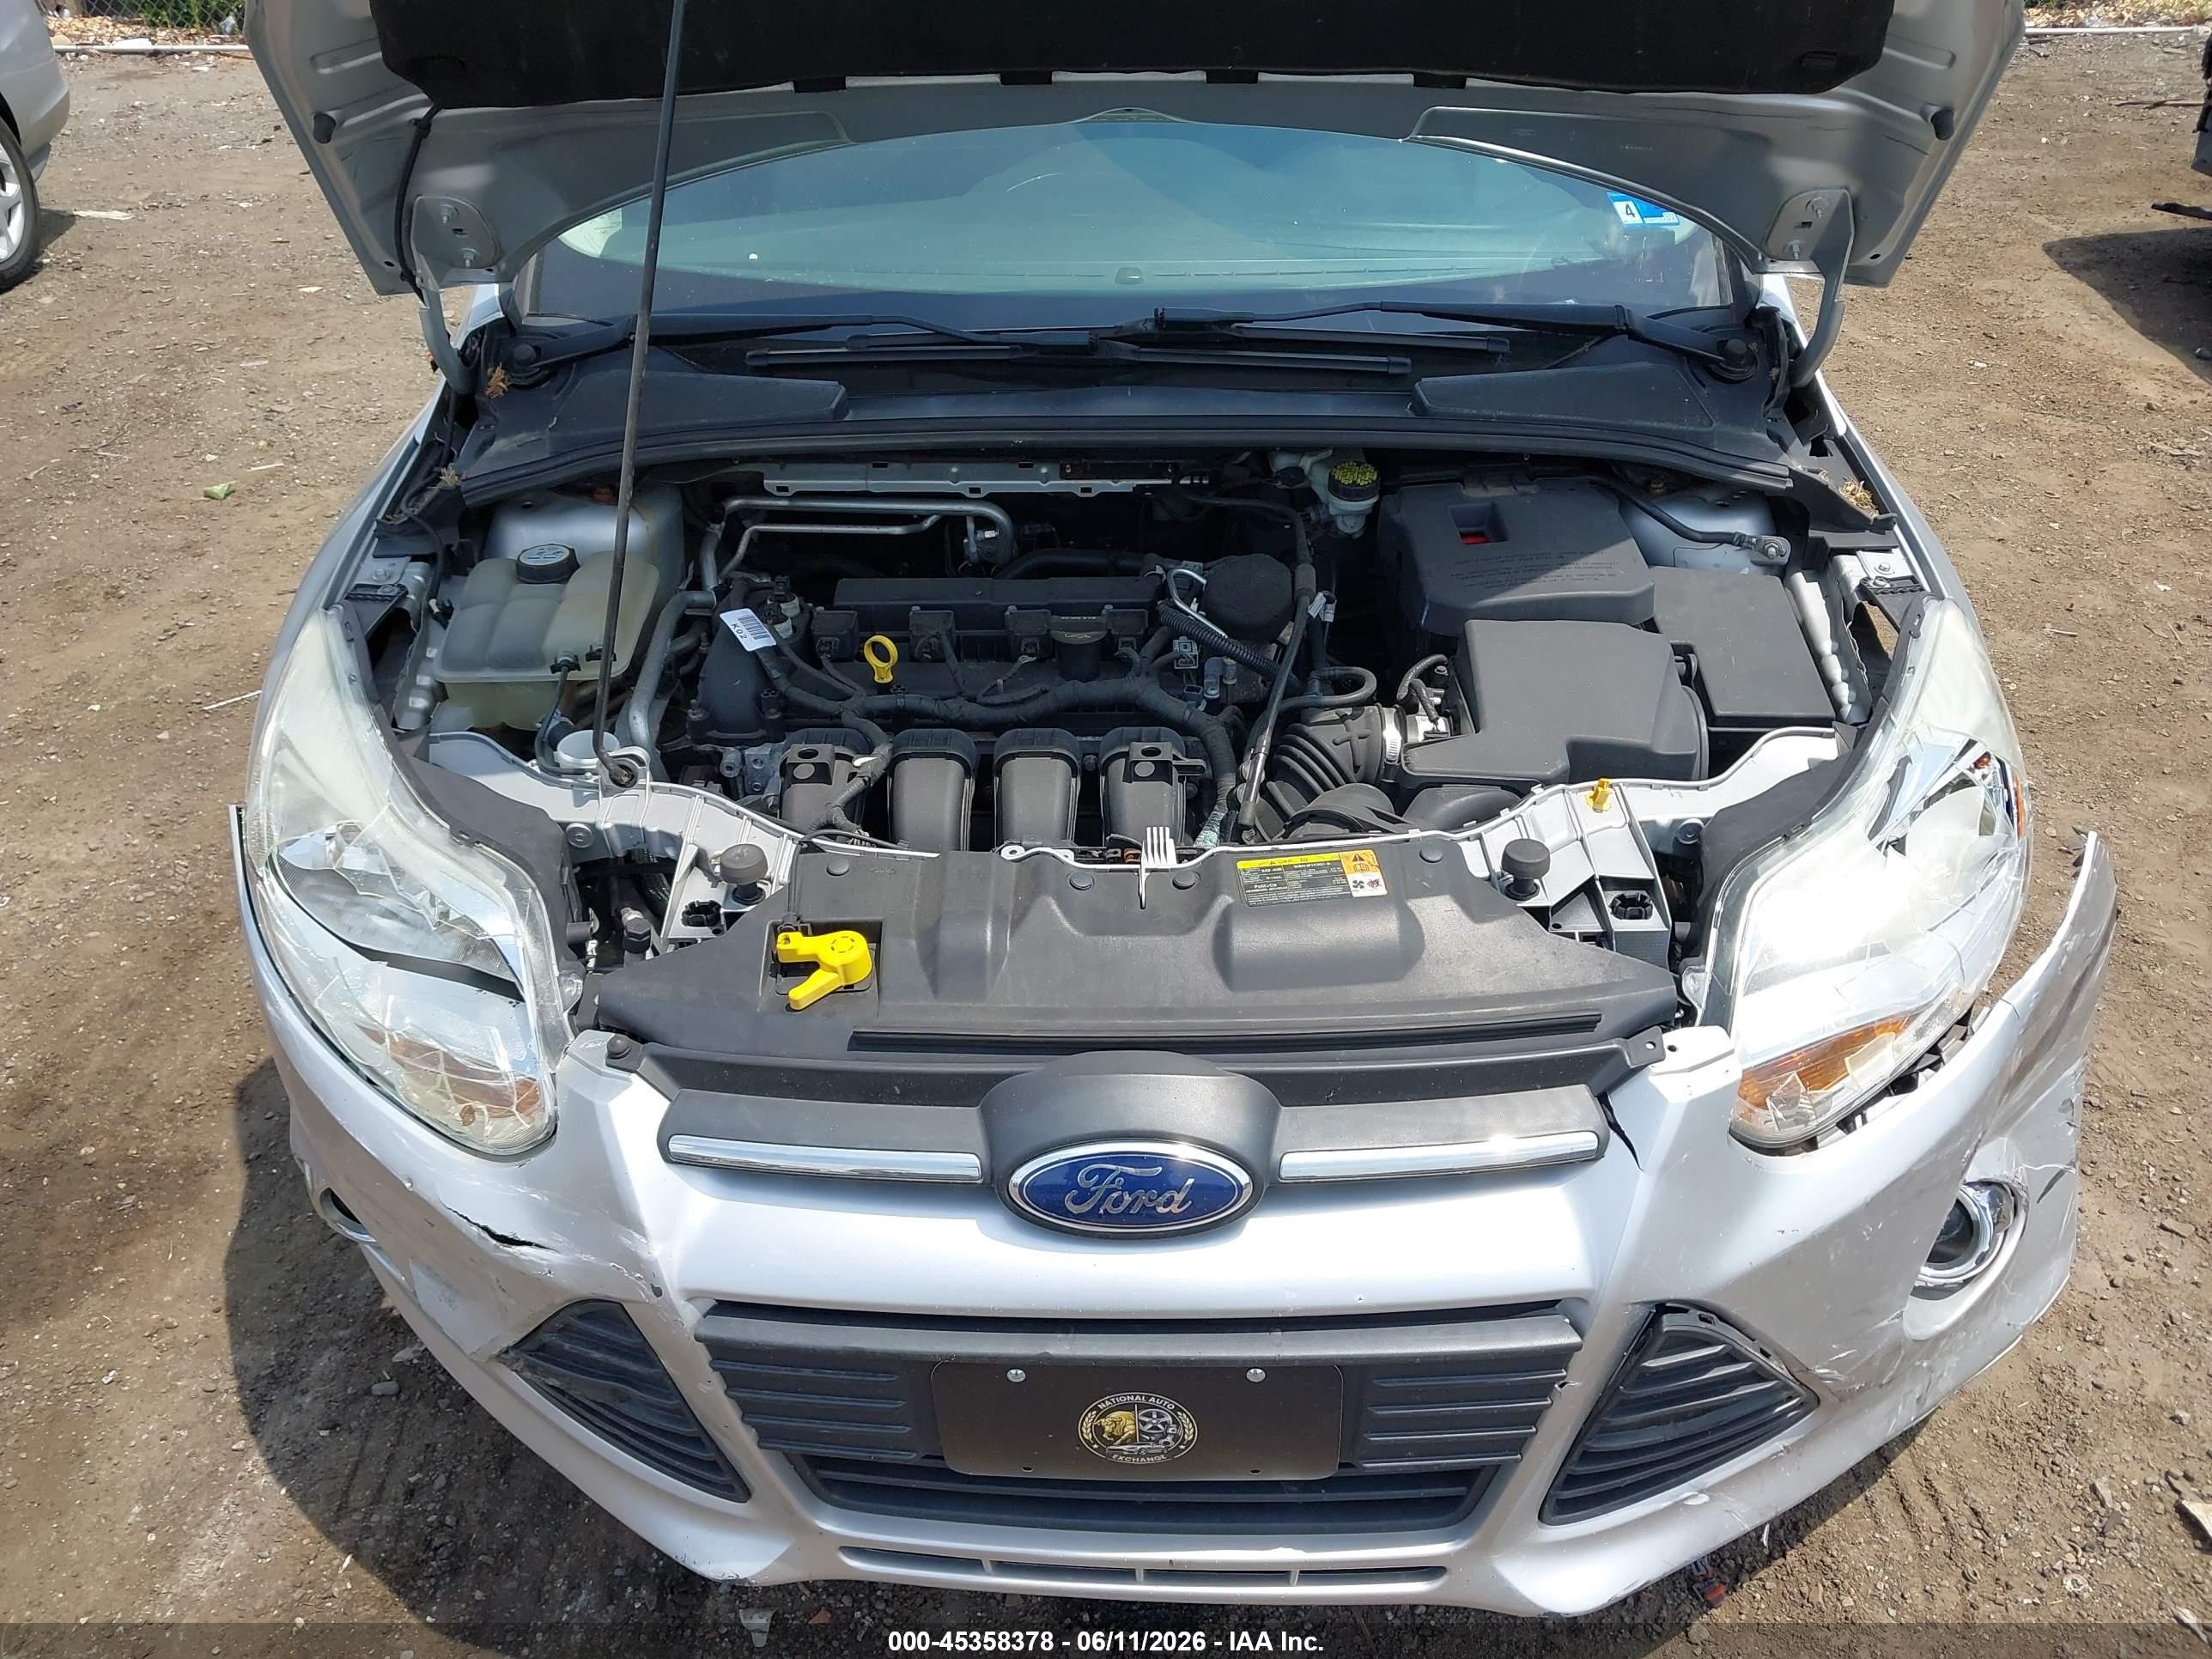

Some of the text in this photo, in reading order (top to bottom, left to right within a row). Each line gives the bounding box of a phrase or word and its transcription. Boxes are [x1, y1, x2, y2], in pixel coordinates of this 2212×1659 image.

[1625, 203, 1636, 218] 4
[731, 623, 748, 640] K02
[1064, 1164, 1196, 1214] Ford
[1097, 1395, 1176, 1410] NATIONAL AUTO
[1112, 1454, 1168, 1462] EXCHANGE
